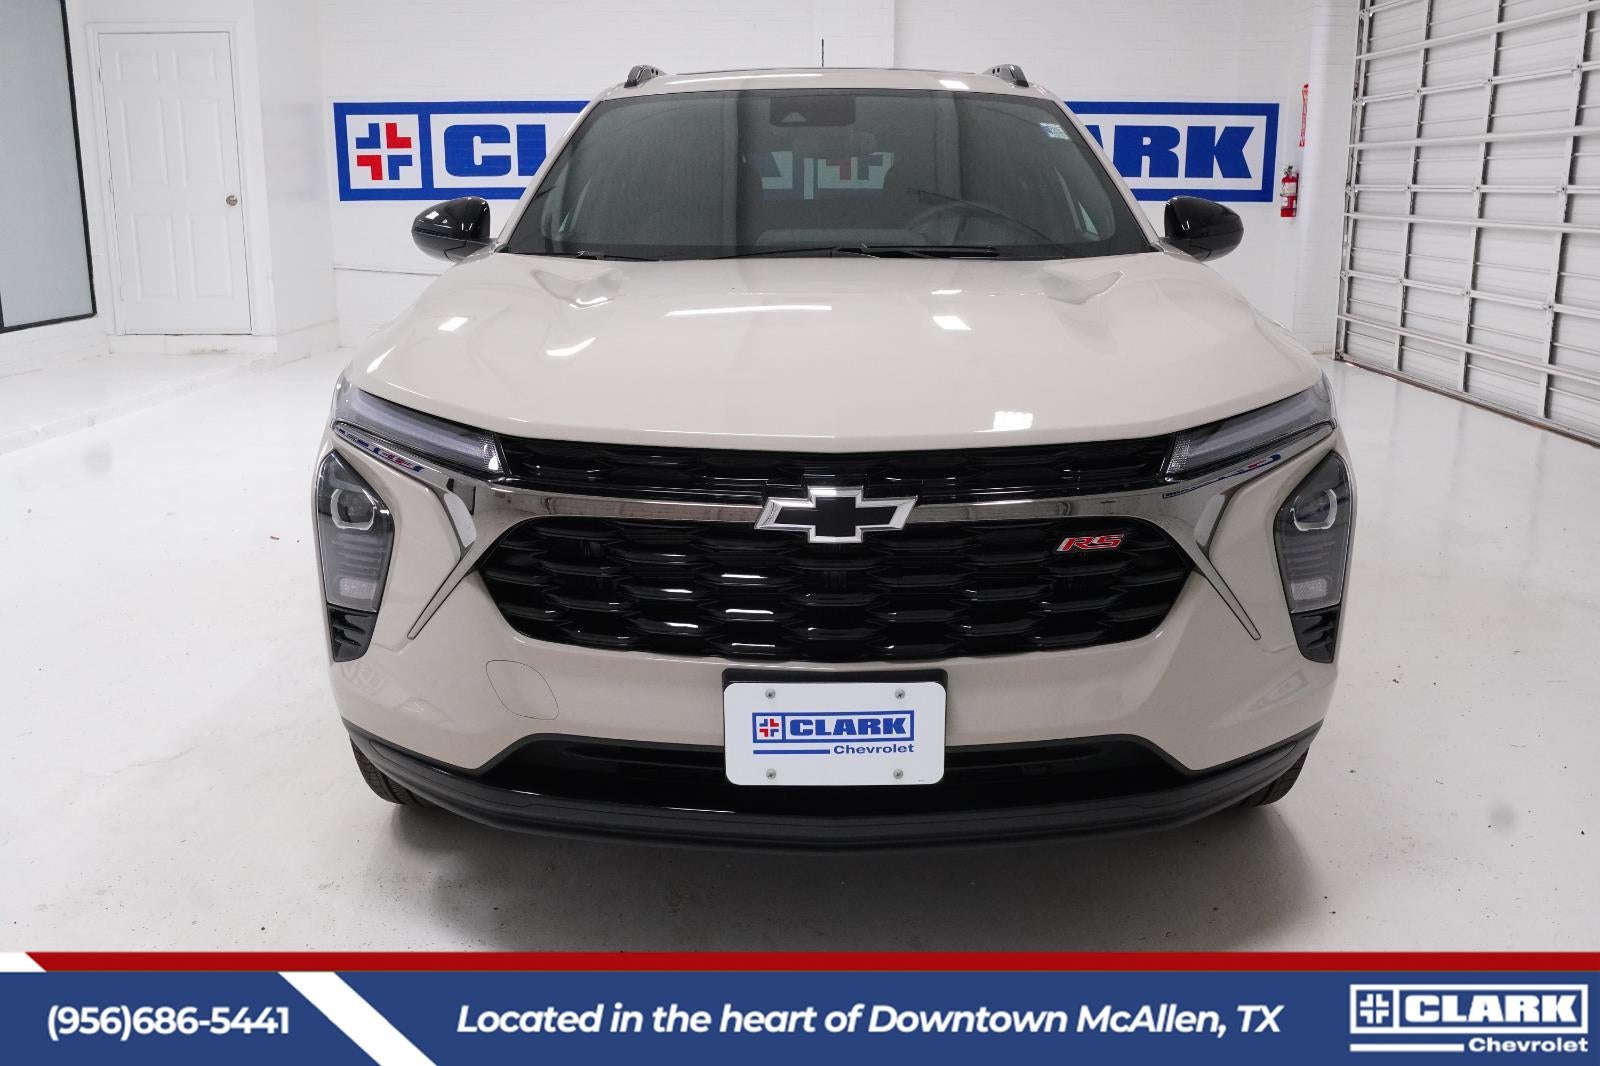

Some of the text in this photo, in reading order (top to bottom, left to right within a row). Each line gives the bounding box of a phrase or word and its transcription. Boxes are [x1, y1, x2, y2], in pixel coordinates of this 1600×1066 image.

[1085, 124, 1254, 179] RK
[1056, 533, 1125, 552] RS
[789, 717, 907, 736] CLARK
[833, 743, 914, 755] Chevrolet
